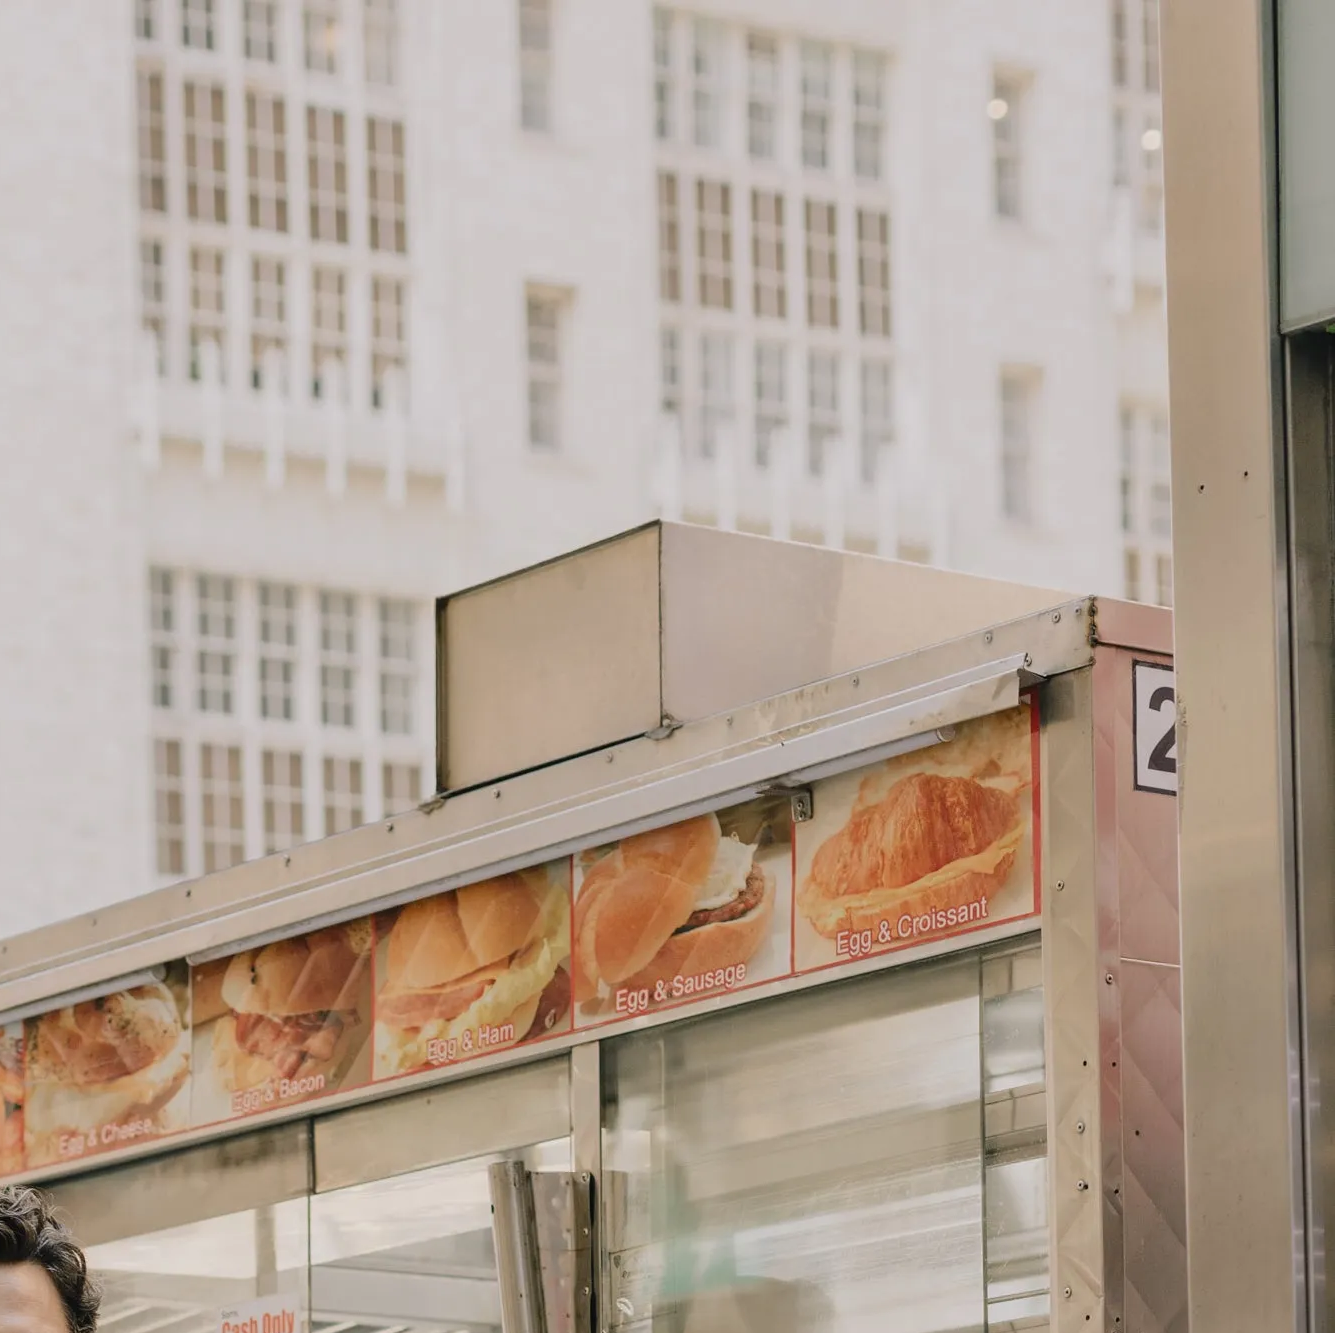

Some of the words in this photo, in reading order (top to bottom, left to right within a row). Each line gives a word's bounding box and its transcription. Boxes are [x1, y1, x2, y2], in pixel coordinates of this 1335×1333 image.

[837, 930, 871, 956] Egg
[878, 921, 891, 943] &
[897, 895, 988, 938] Croissant
[616, 989, 648, 1013] Egg
[654, 980, 667, 1001] &
[672, 963, 746, 997] Sausage
[427, 1038, 457, 1062] Egg
[462, 1032, 473, 1050] &
[479, 1024, 514, 1046] Ham
[232, 1091, 262, 1113] Egg
[264, 1083, 275, 1102] &
[279, 1073, 325, 1097] Bacon
[59, 1134, 85, 1156] Egg
